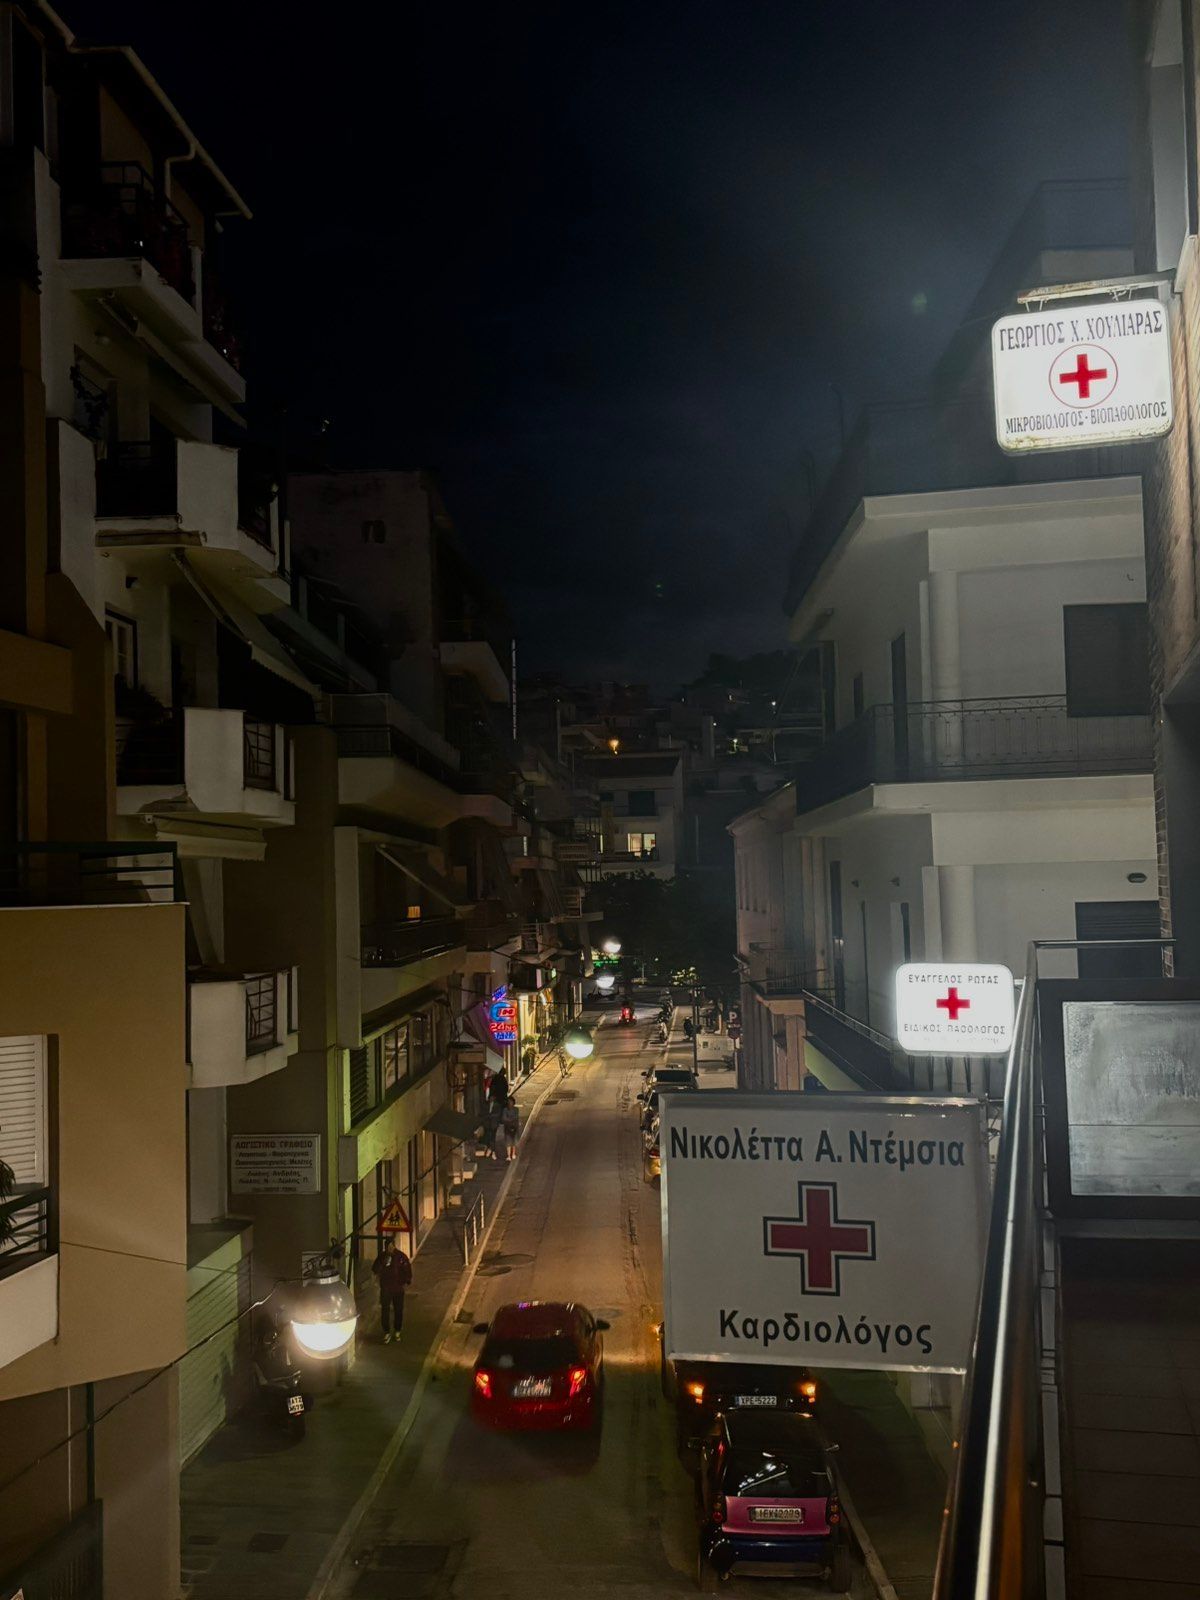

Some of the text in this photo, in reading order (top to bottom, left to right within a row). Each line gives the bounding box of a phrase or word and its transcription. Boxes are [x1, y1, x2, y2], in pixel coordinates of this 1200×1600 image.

[1000, 310, 1163, 351] ΓΕΩΡΓΙΟΣ Χ. ΧΟΥΛΙΑΡΑΣ
[908, 974, 999, 984] ΕΥΑΓΓΕΛΟΣ ΡΩΤΑΣ
[904, 1023, 942, 1033] ΕΙΔΙΚΟΣ
[670, 1126, 965, 1171] Νικολέττα Α. Ντέμσια
[719, 1309, 933, 1354] Καρδιολόγος
